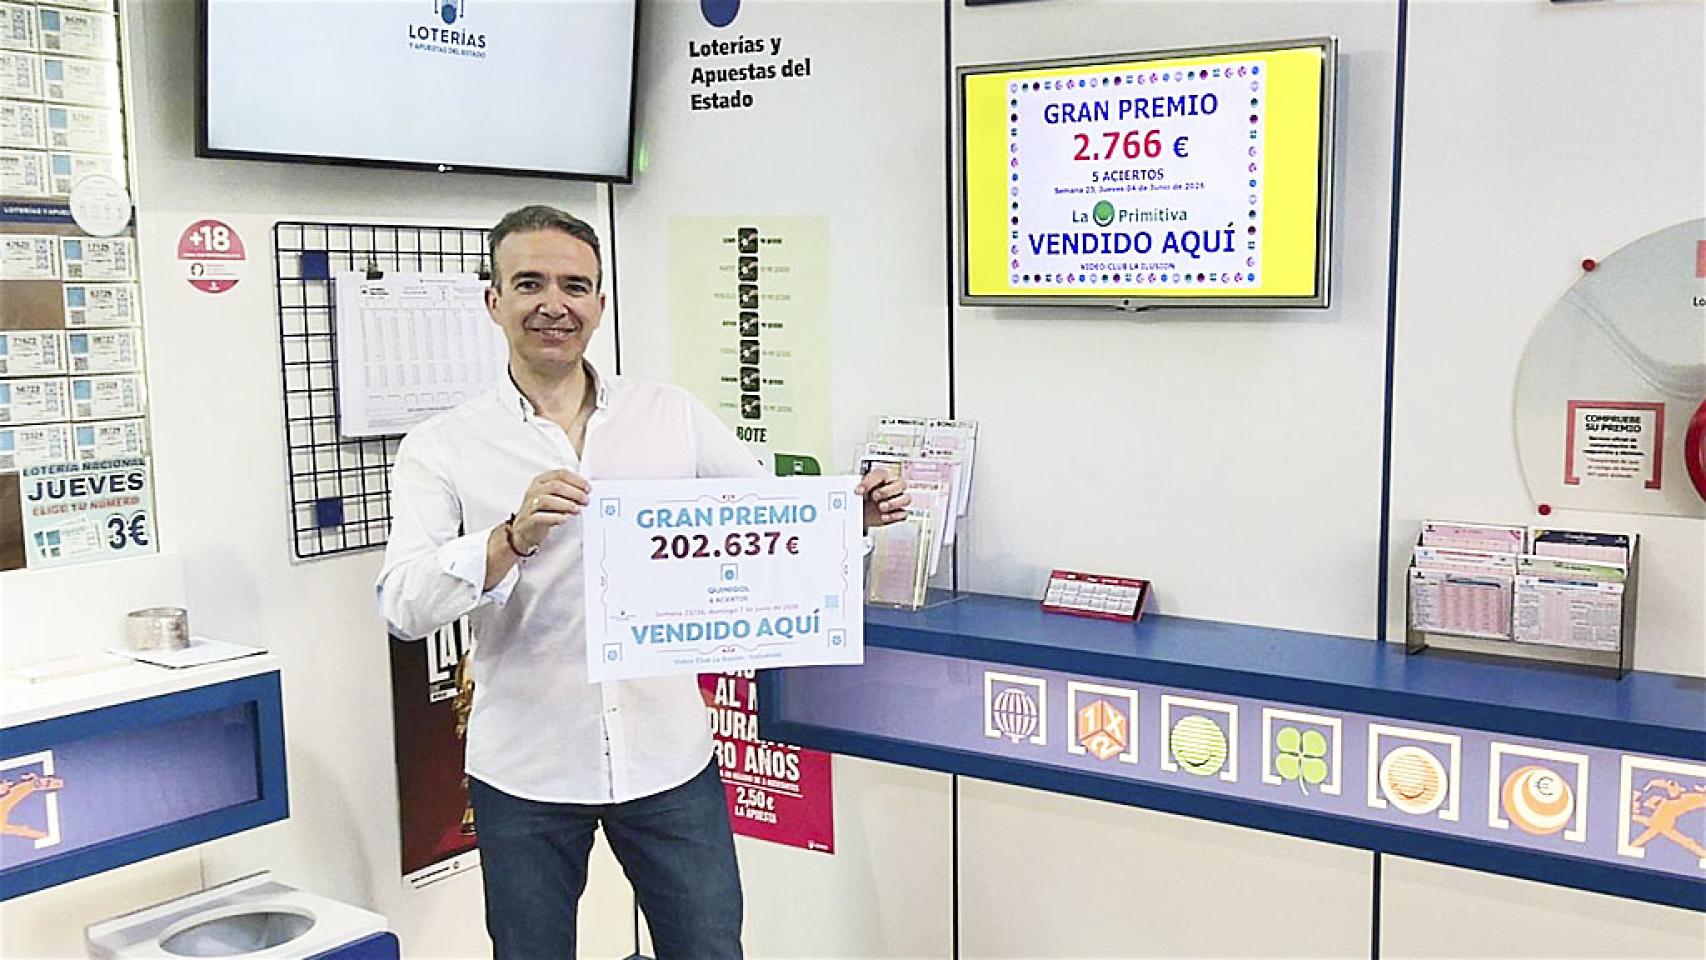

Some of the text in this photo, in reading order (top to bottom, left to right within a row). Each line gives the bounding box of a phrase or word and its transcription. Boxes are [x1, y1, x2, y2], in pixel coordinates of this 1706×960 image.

[409, 24, 486, 48] LOTERÍAS
[689, 35, 782, 57] Loterías y
[691, 58, 811, 87] Apuestas del
[691, 90, 754, 110] Estado
[1044, 93, 1218, 124] GRAN PREMIO
[1074, 130, 1189, 161] 2.766 €
[1092, 168, 1164, 182] 5 ACIERTOS
[1072, 208, 1188, 223] La Primitiva
[190, 226, 230, 250] +18
[1028, 222, 1236, 258] VENDIDO AQUÍ
[736, 426, 767, 442] BOTE
[28, 472, 144, 500] JUEVES
[636, 504, 817, 529] GRAN PREMIO
[108, 514, 148, 549] 3€
[650, 532, 799, 560] 202.637 €
[631, 608, 820, 645] VENDIDO AQUÍ
[714, 678, 742, 707] AL
